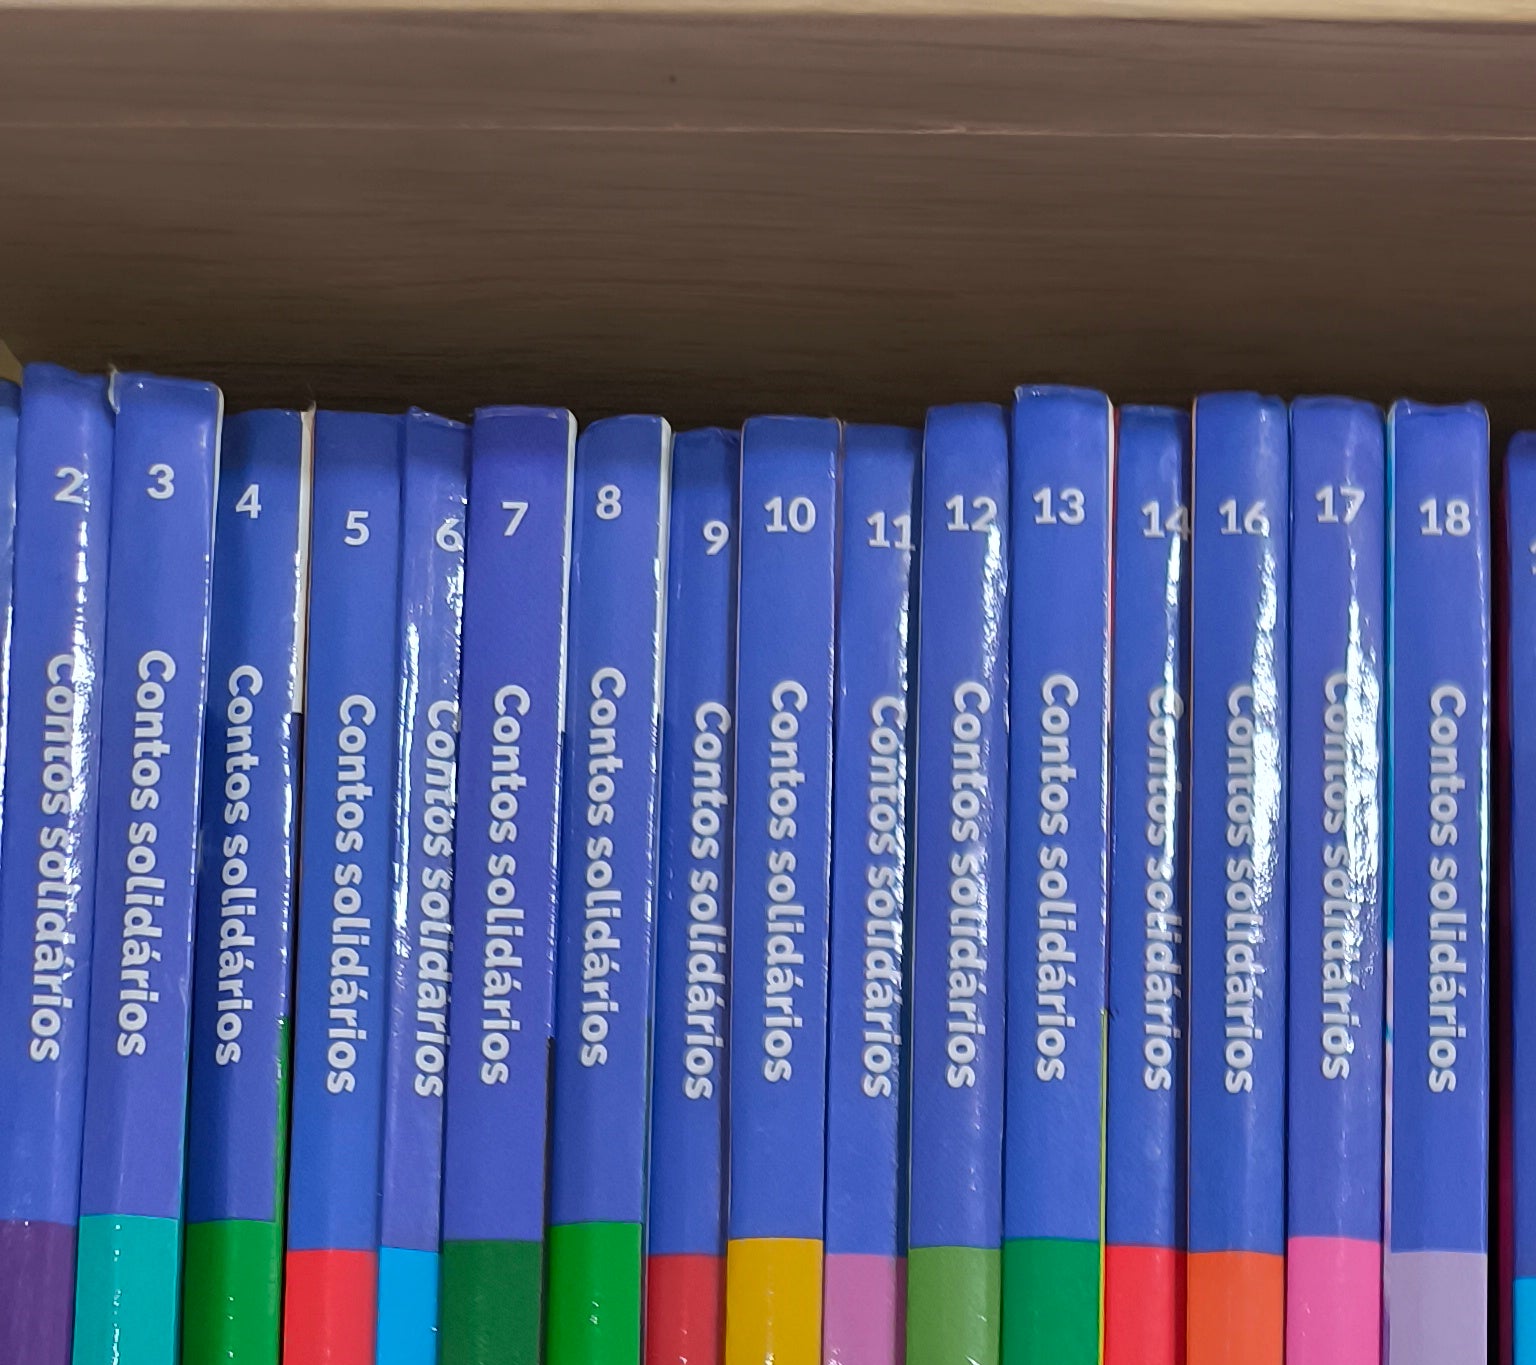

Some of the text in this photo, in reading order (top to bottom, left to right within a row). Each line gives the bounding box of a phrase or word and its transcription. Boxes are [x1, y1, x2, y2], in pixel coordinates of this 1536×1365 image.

[54, 467, 88, 503] 2
[148, 464, 175, 500] 3
[236, 485, 262, 519] 4
[502, 501, 529, 536] 7
[596, 485, 621, 520] 8
[765, 497, 816, 534] 10
[946, 497, 998, 532] 12
[1032, 488, 1085, 525] 13
[1219, 500, 1269, 536] 16
[1316, 487, 1365, 523] 17
[1420, 501, 1470, 536] 18
[344, 511, 370, 545] 5
[435, 518, 464, 552] 6
[703, 520, 729, 556] 9
[866, 511, 916, 551] 11
[1141, 502, 1190, 541] 14
[117, 650, 176, 1056] Contos solidários
[216, 665, 262, 1066] Contos solidários
[580, 668, 626, 1068] Contos solidários
[326, 694, 376, 1095] Contos solidários
[480, 685, 530, 1085] Contos solidários
[763, 679, 807, 1084] Contos solidários
[864, 696, 906, 1098] Contos solidários
[946, 681, 990, 1090] Contos solidários
[1036, 674, 1079, 1082] Contos solidários
[1428, 685, 1467, 1094] Contos solidários
[415, 701, 459, 1097] Contos solidários
[684, 702, 731, 1100] Contos solidários
